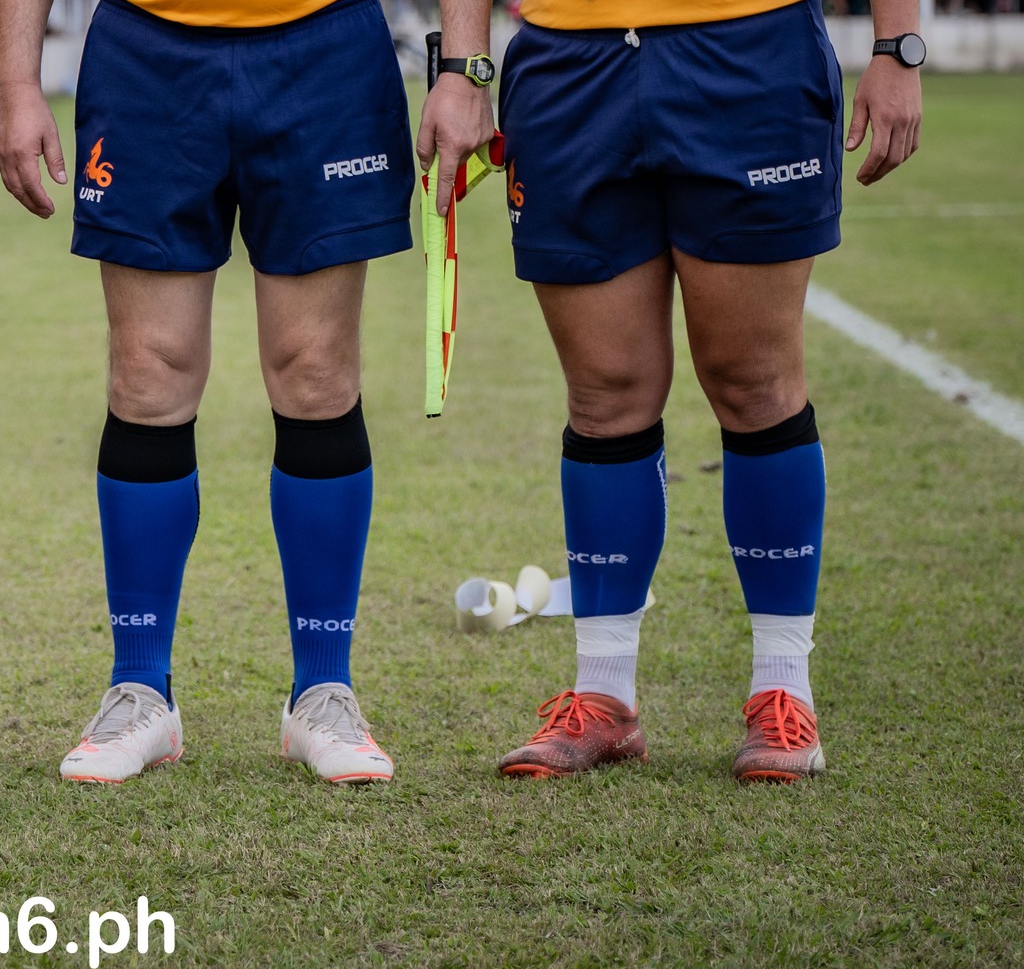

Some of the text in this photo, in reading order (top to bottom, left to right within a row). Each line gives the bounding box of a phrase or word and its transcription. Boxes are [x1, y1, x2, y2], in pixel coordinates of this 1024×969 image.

[322, 153, 390, 181] PROCER
[747, 158, 823, 187] PROCER
[77, 185, 107, 203] URT
